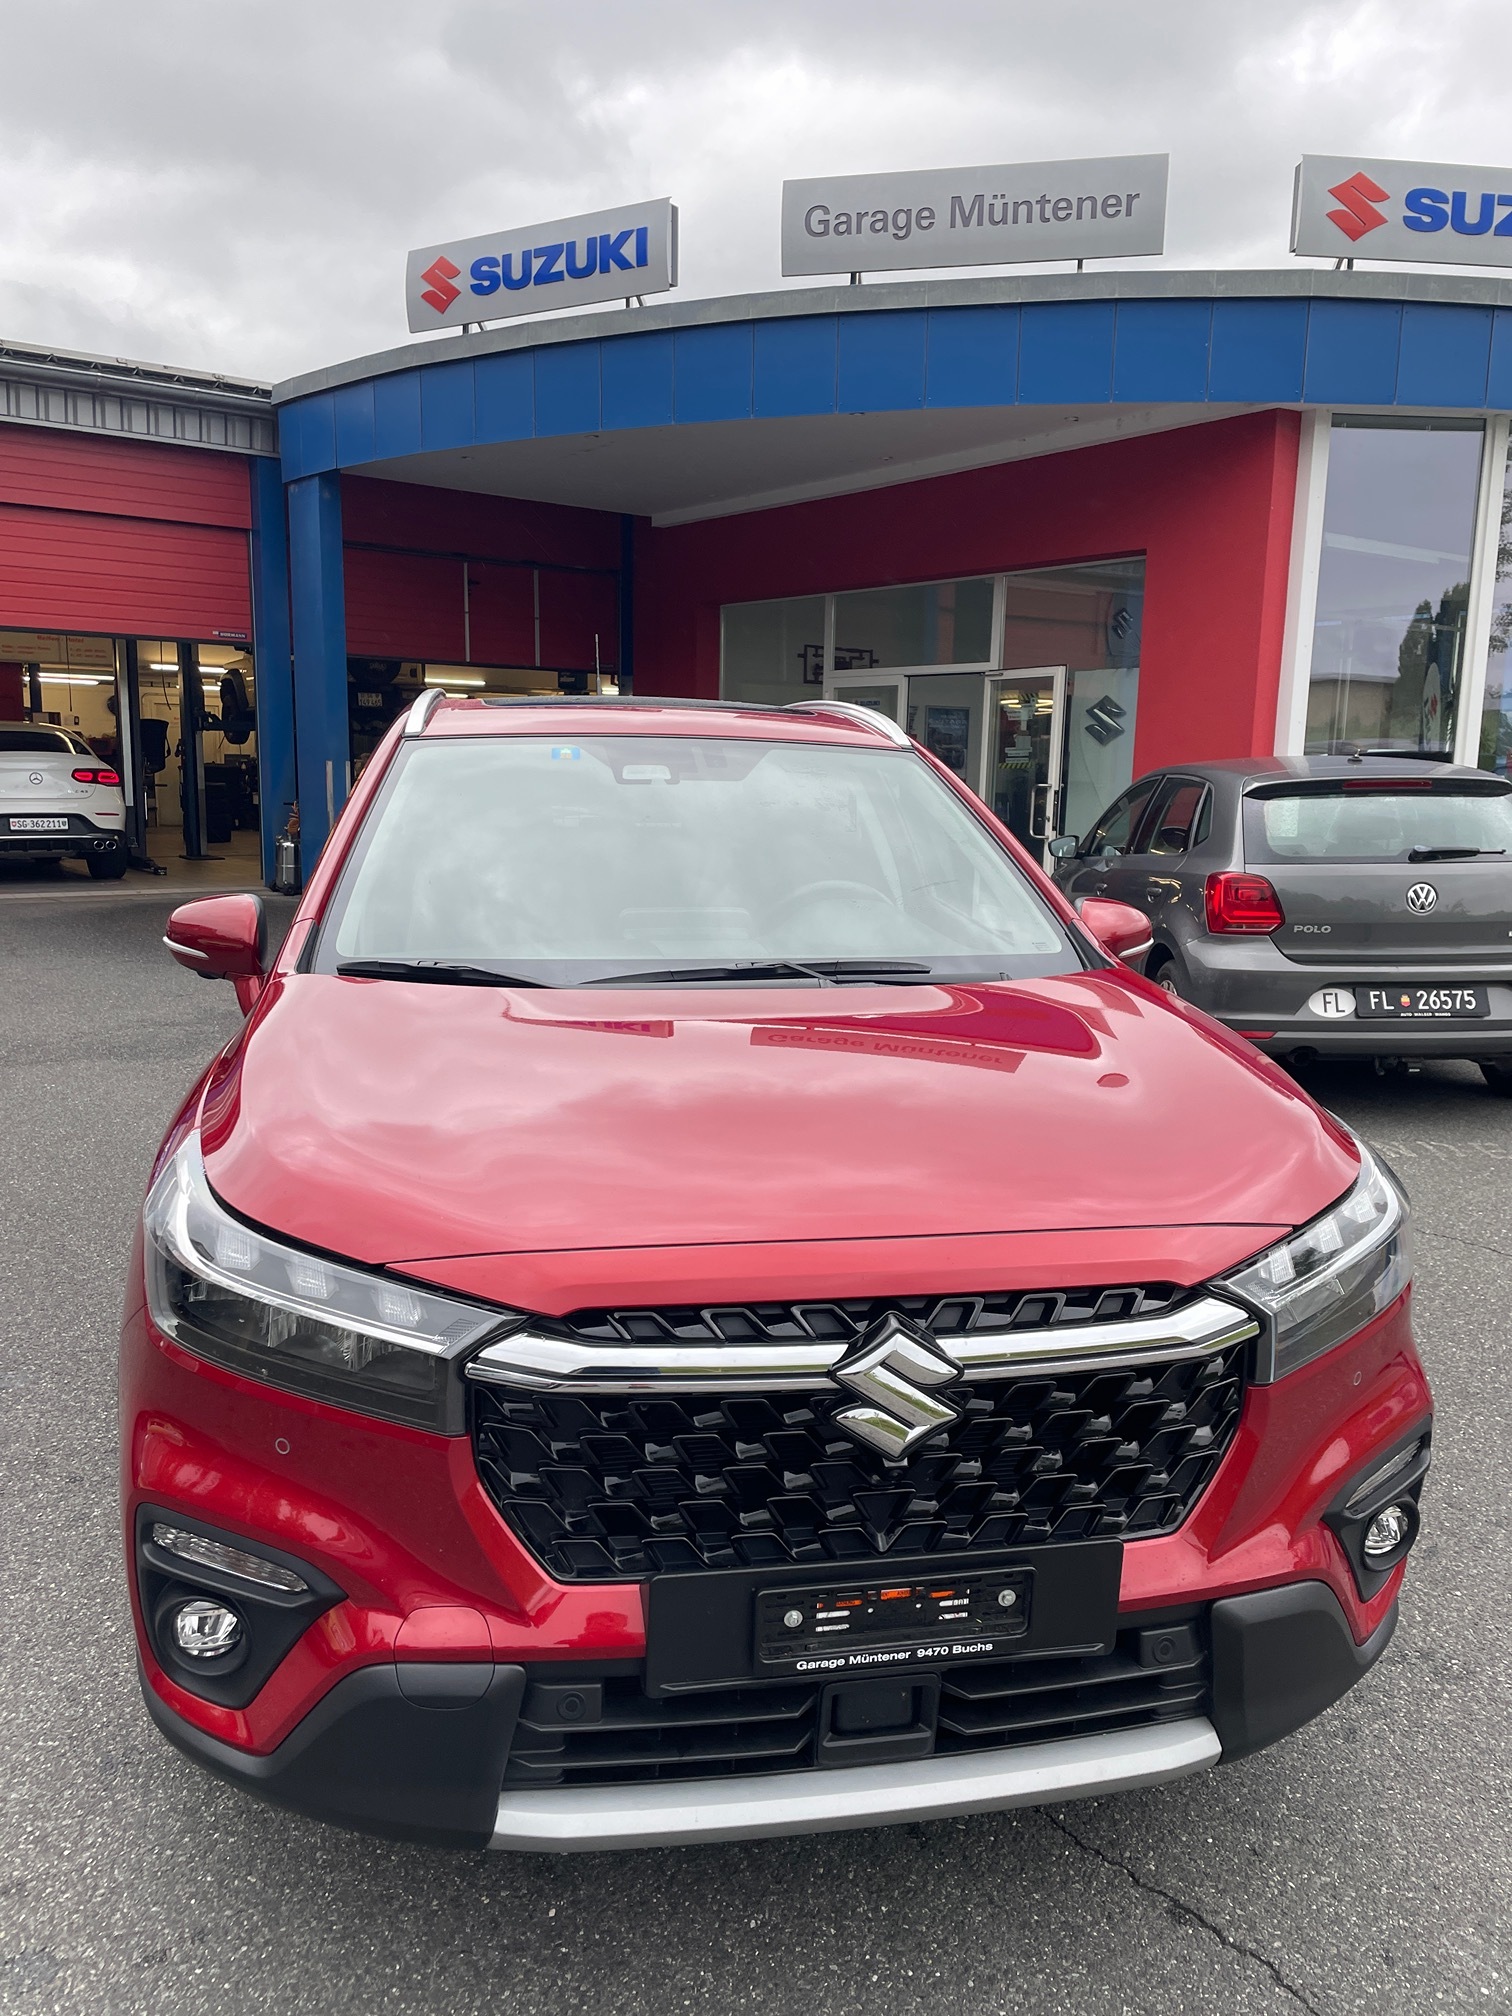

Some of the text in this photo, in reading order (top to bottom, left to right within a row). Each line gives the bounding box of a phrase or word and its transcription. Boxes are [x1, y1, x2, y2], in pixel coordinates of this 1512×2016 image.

[803, 189, 1141, 241] Garage Müntener
[469, 226, 649, 294] SUZUKI
[1293, 925, 1332, 934] POLO
[1322, 992, 1346, 1014] FL
[1369, 990, 1477, 1010] FL 26575
[796, 1643, 993, 1670] Garage Müntener 9470 Buchs
